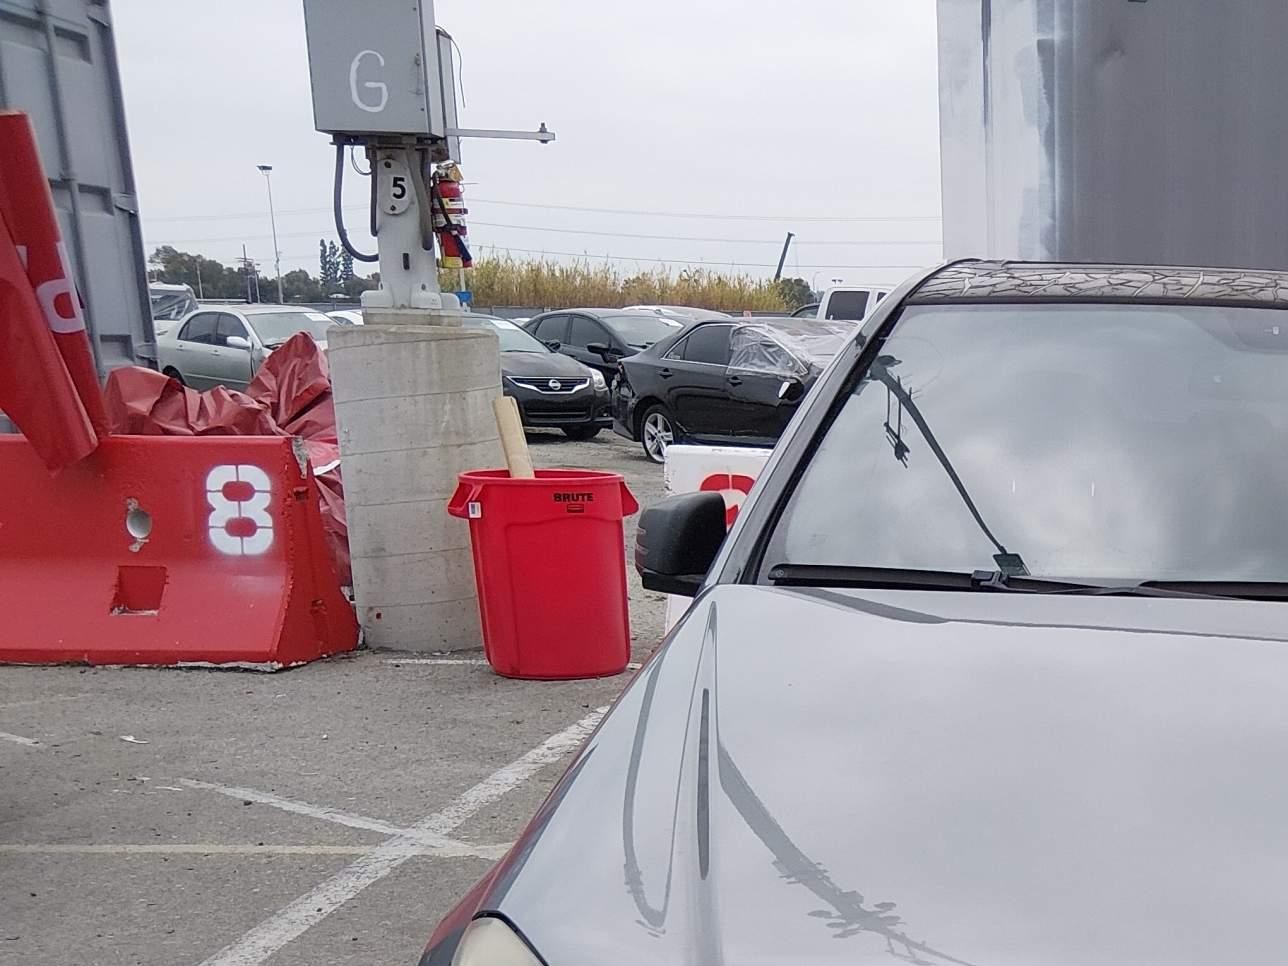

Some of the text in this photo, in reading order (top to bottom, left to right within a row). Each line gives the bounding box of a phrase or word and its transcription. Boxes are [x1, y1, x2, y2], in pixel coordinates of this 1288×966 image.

[350, 49, 389, 113] G
[392, 176, 407, 200] 5
[206, 464, 274, 556] 8
[553, 492, 594, 503] BRUTE
